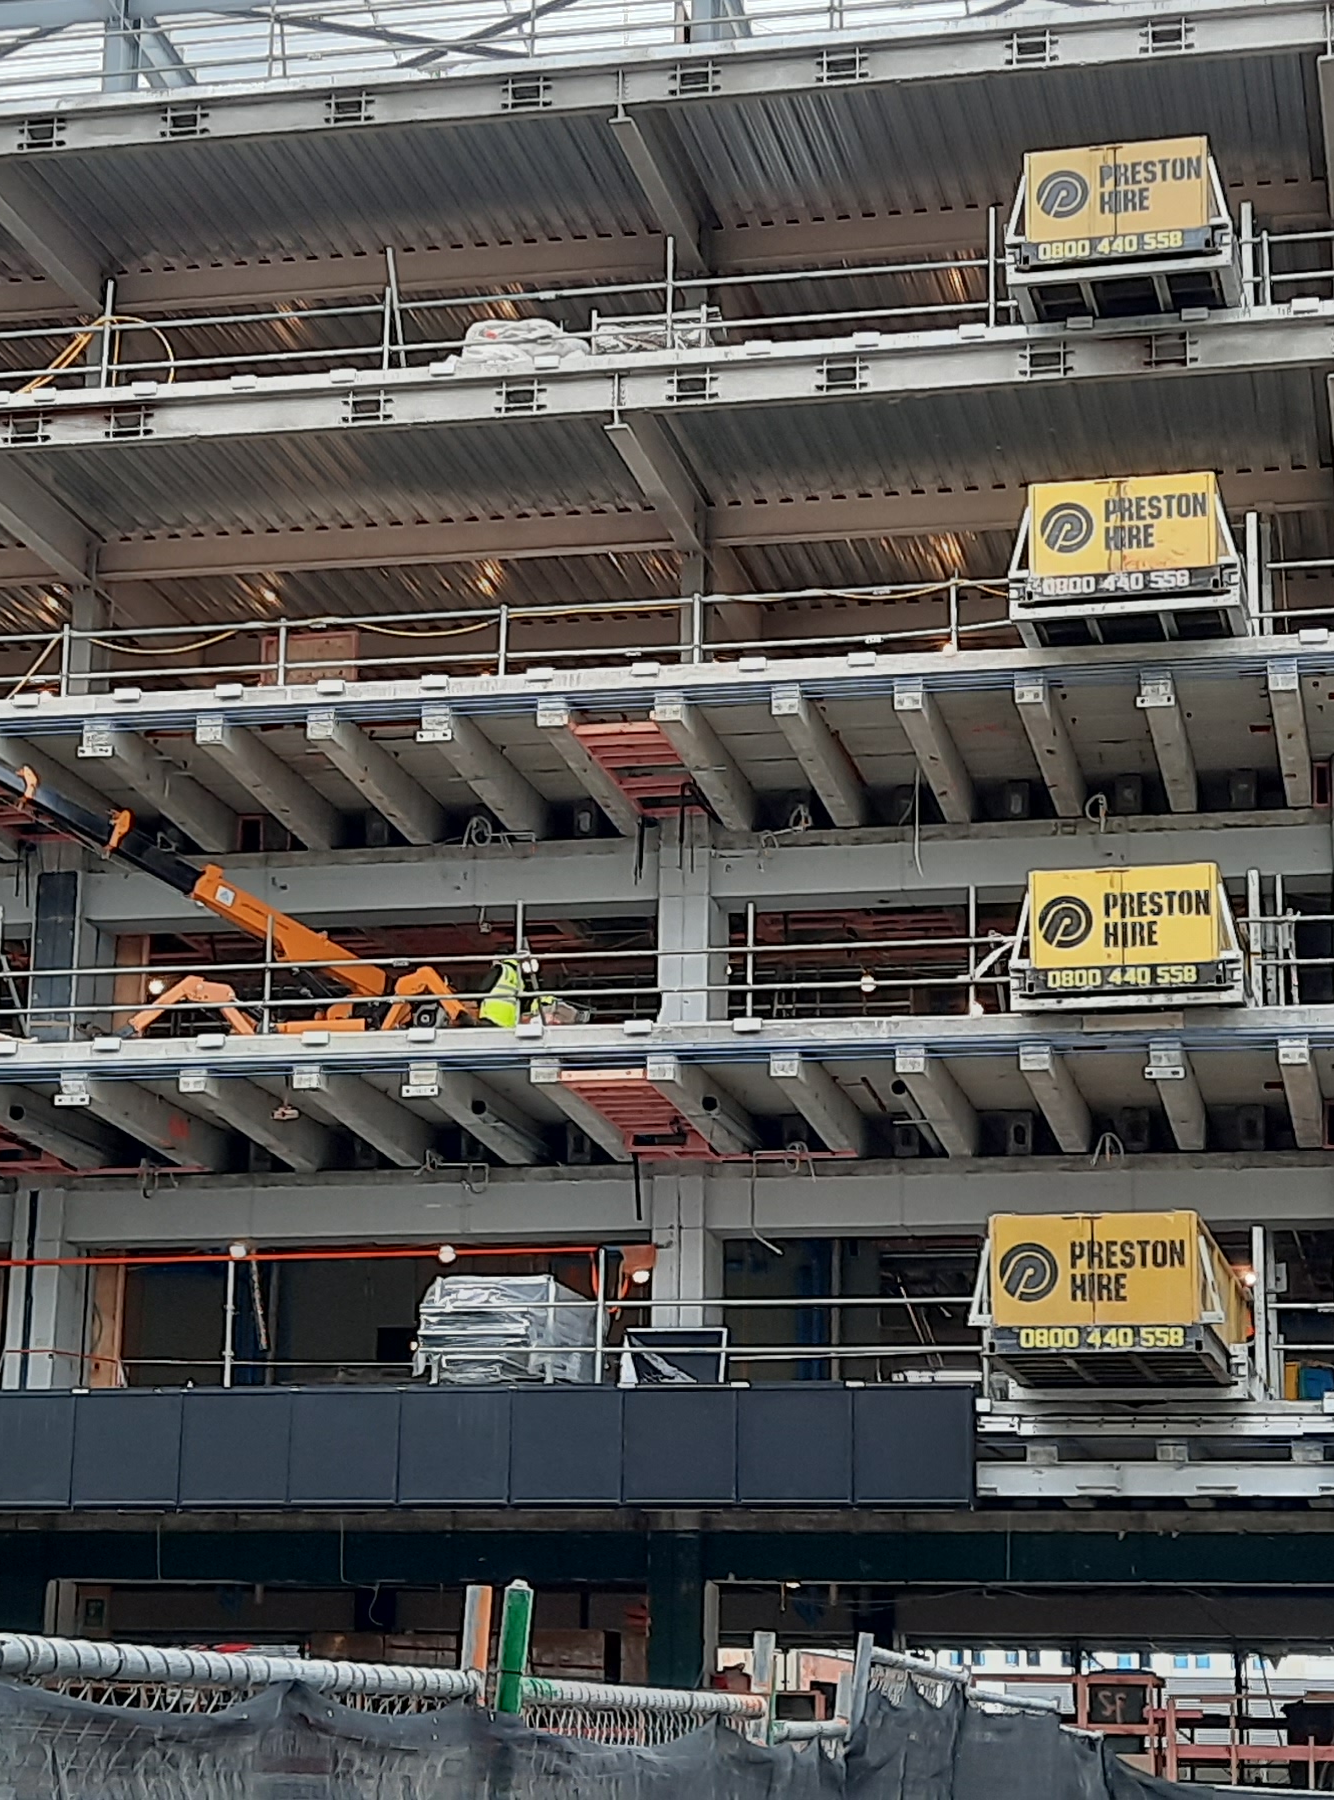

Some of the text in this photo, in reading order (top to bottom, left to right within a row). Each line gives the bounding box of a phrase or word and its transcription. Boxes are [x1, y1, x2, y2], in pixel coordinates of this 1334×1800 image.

[1099, 156, 1202, 188] PRESTON
[1099, 187, 1150, 215] HIRE
[1038, 231, 1183, 261] 0800 440 558
[1104, 492, 1208, 523] PRESTON
[1104, 523, 1155, 550] HIRE
[1042, 570, 1190, 596] 0800 440 558
[1104, 889, 1211, 918] PRESTON
[1104, 920, 1158, 947] HIRE
[1047, 965, 1197, 988] 0800 440 558
[1070, 1240, 1185, 1269] PRESTON
[1070, 1273, 1128, 1302] HIRE
[1020, 1326, 1185, 1349] 0800 440 558
